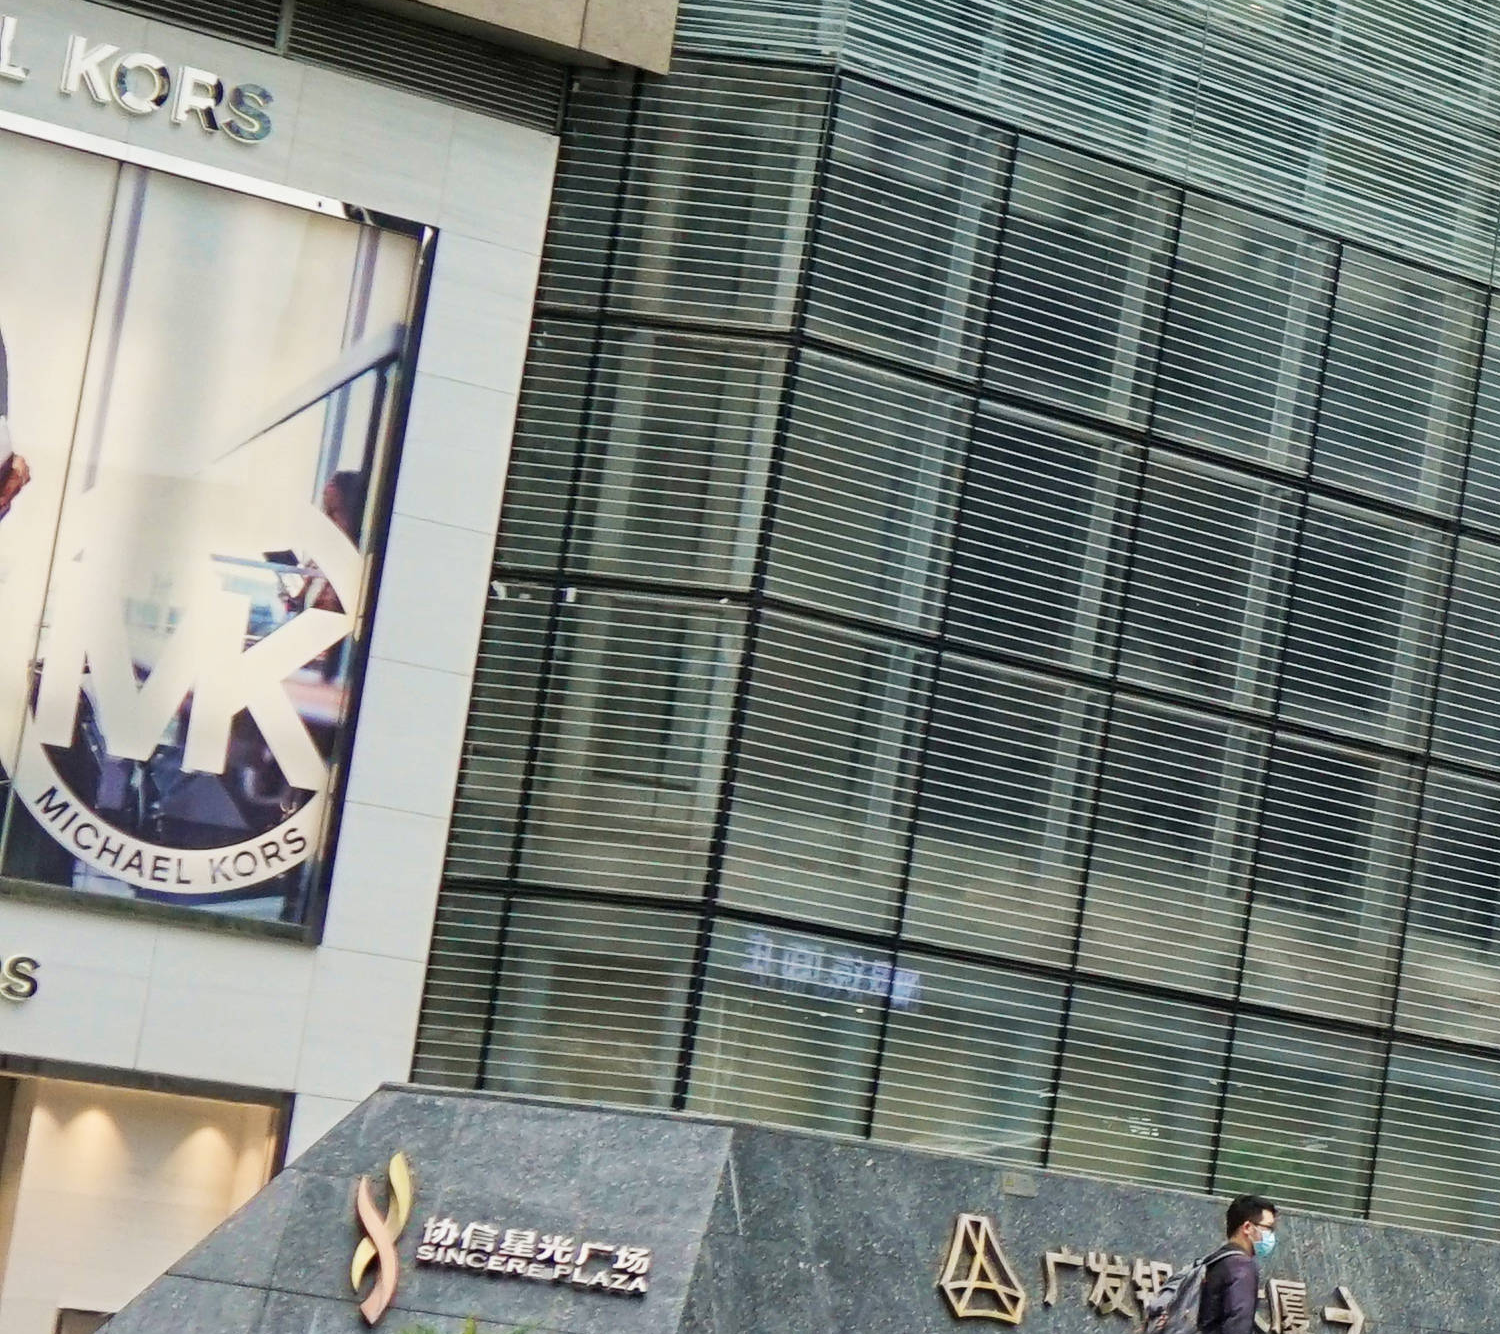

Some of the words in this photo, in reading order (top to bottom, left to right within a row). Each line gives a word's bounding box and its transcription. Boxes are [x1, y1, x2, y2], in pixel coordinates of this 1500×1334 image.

[60, 34, 274, 145] KORS
[35, 785, 192, 886] MICHAEL
[208, 827, 307, 885] KORS
[416, 1245, 546, 1279] SINCERE
[551, 1266, 648, 1294] PLAZA
[422, 1216, 651, 1275] 协信星光广场
